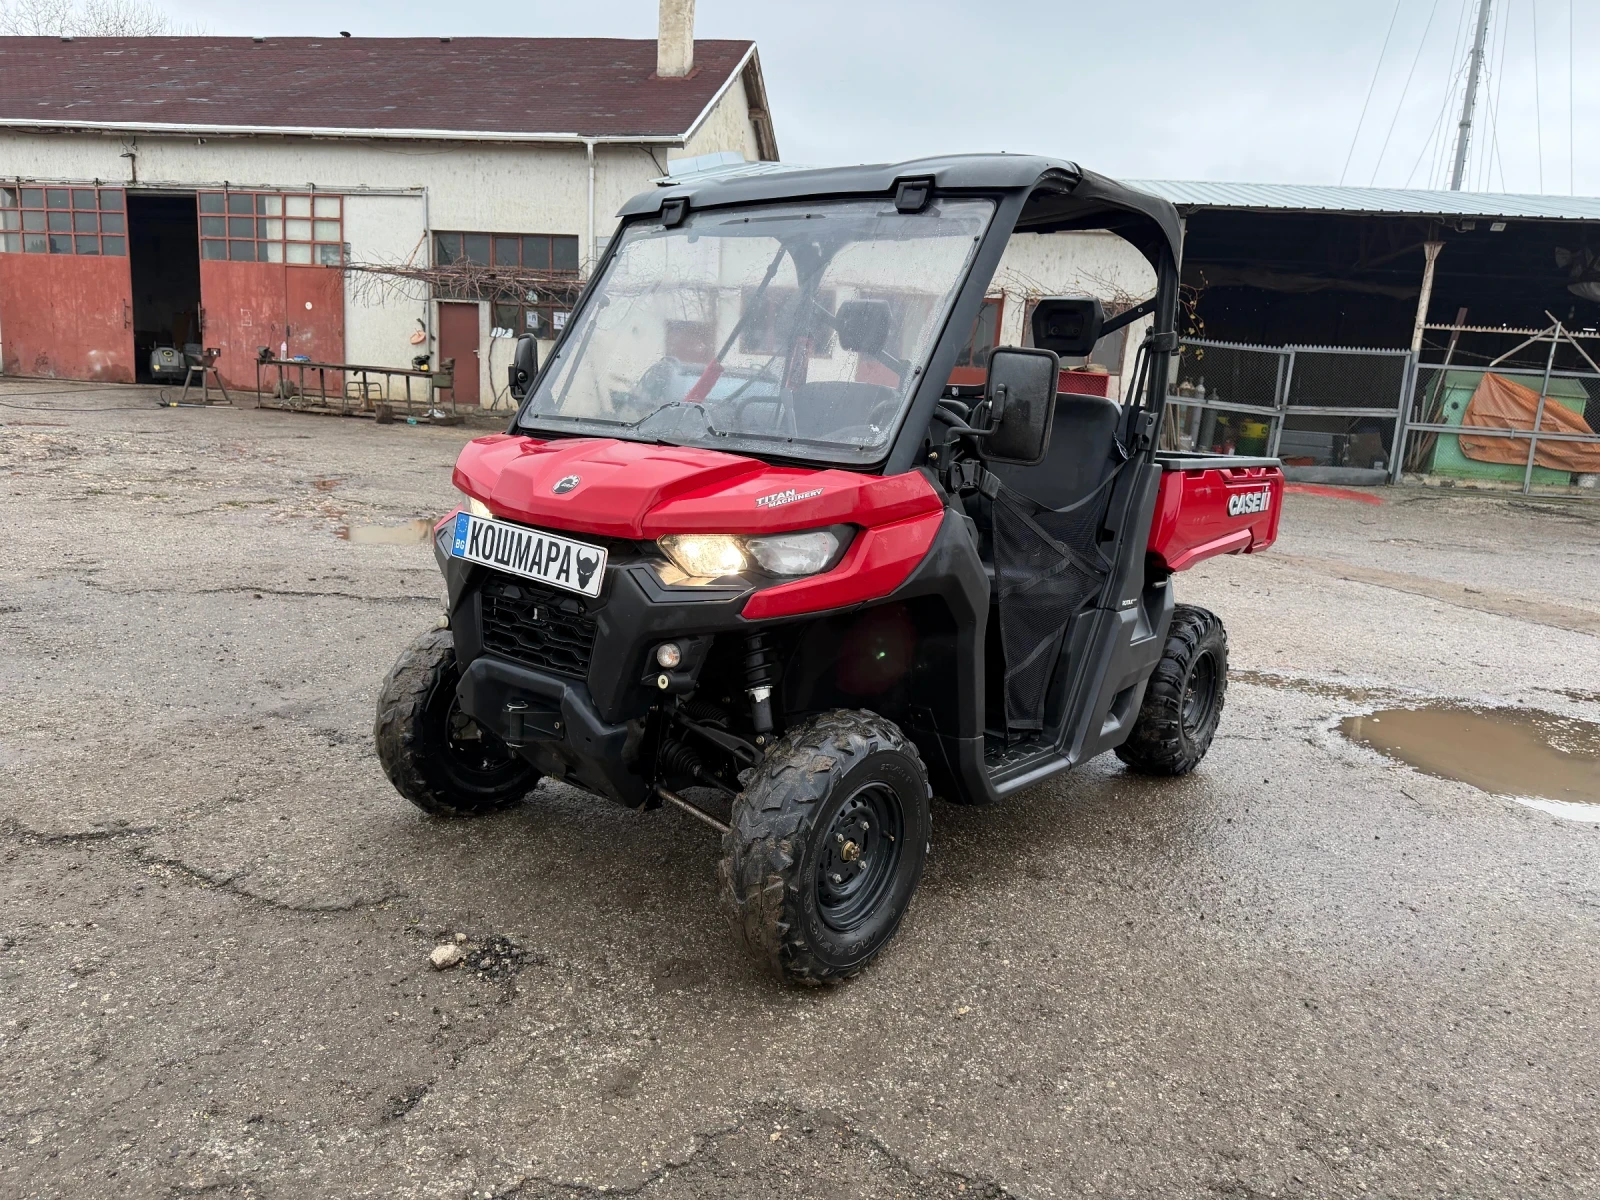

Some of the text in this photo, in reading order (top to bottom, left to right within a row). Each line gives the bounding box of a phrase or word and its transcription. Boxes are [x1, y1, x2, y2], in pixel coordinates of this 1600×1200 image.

[756, 489, 795, 505] TITAN
[768, 488, 824, 508] MACHINERY
[455, 538, 465, 550] BG
[468, 520, 572, 583] КОШМАРА
